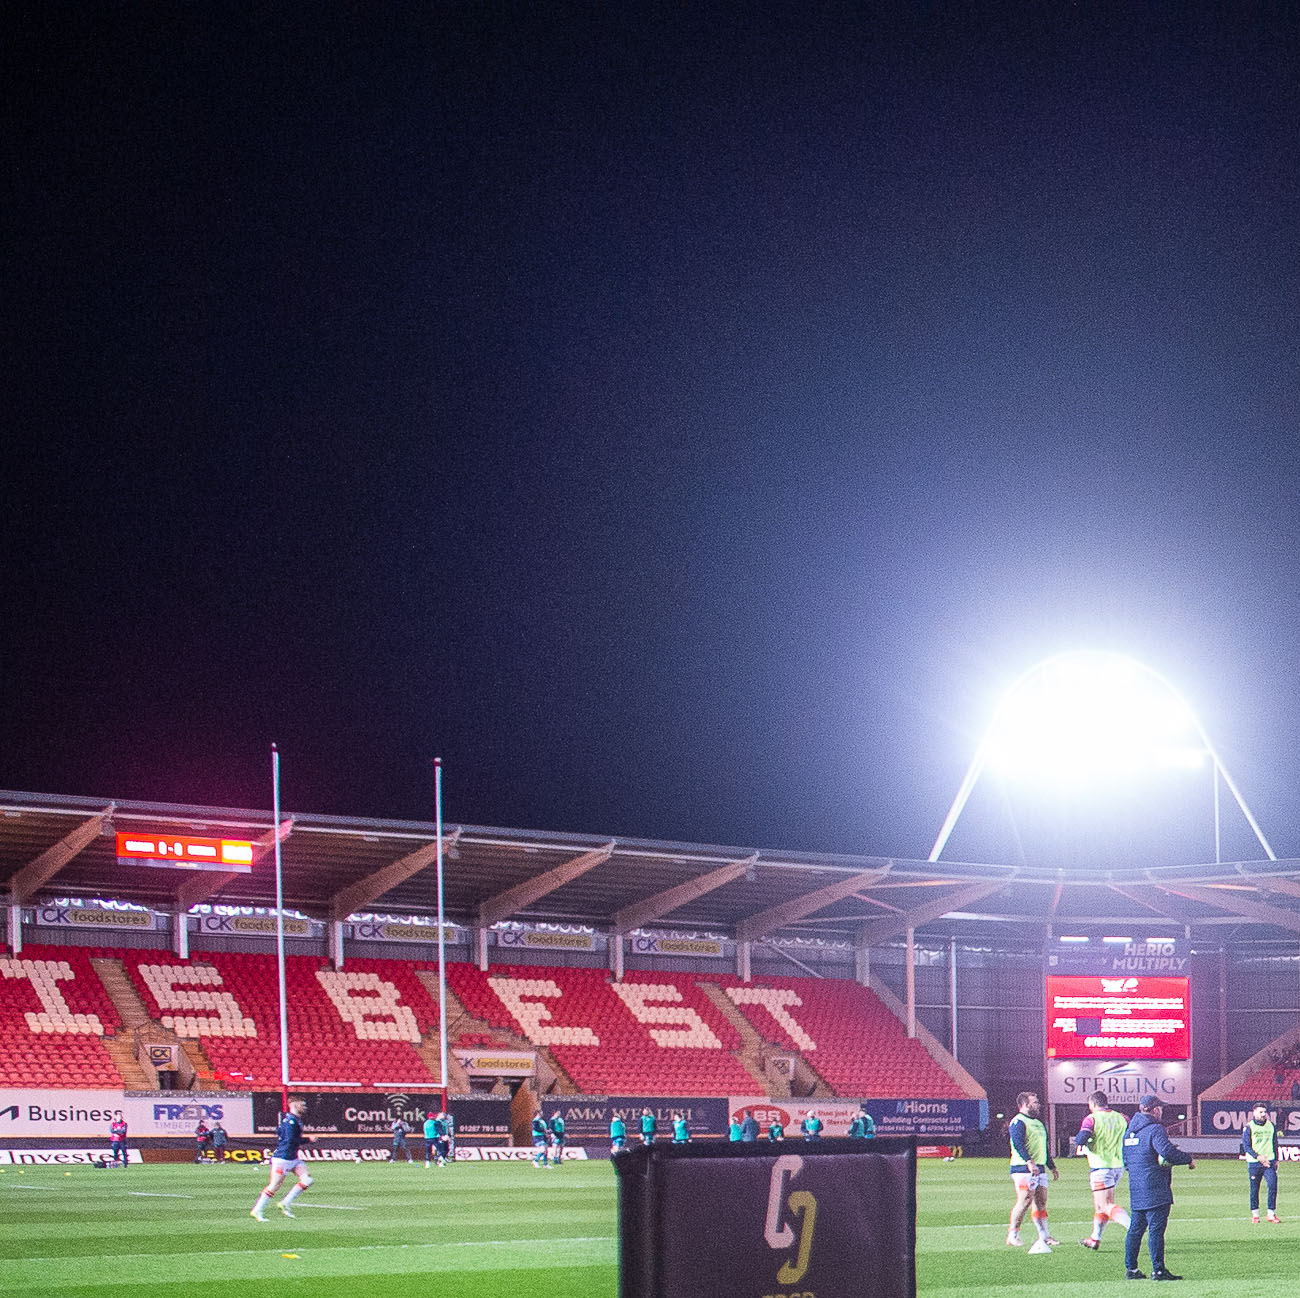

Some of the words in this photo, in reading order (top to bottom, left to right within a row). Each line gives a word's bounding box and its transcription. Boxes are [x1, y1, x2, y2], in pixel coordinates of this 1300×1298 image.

[41, 908, 71, 924] CK
[72, 912, 148, 926] foodstores
[205, 915, 232, 931] CK
[234, 919, 304, 932] foodstres
[359, 924, 384, 939] CK
[504, 932, 524, 945] CK
[636, 937, 656, 951] CK
[1064, 1077, 1176, 1094] STERLING
[154, 1104, 223, 1120] FREDS
[362, 1149, 391, 1161] CUP
[478, 1147, 577, 1161] Invesc
